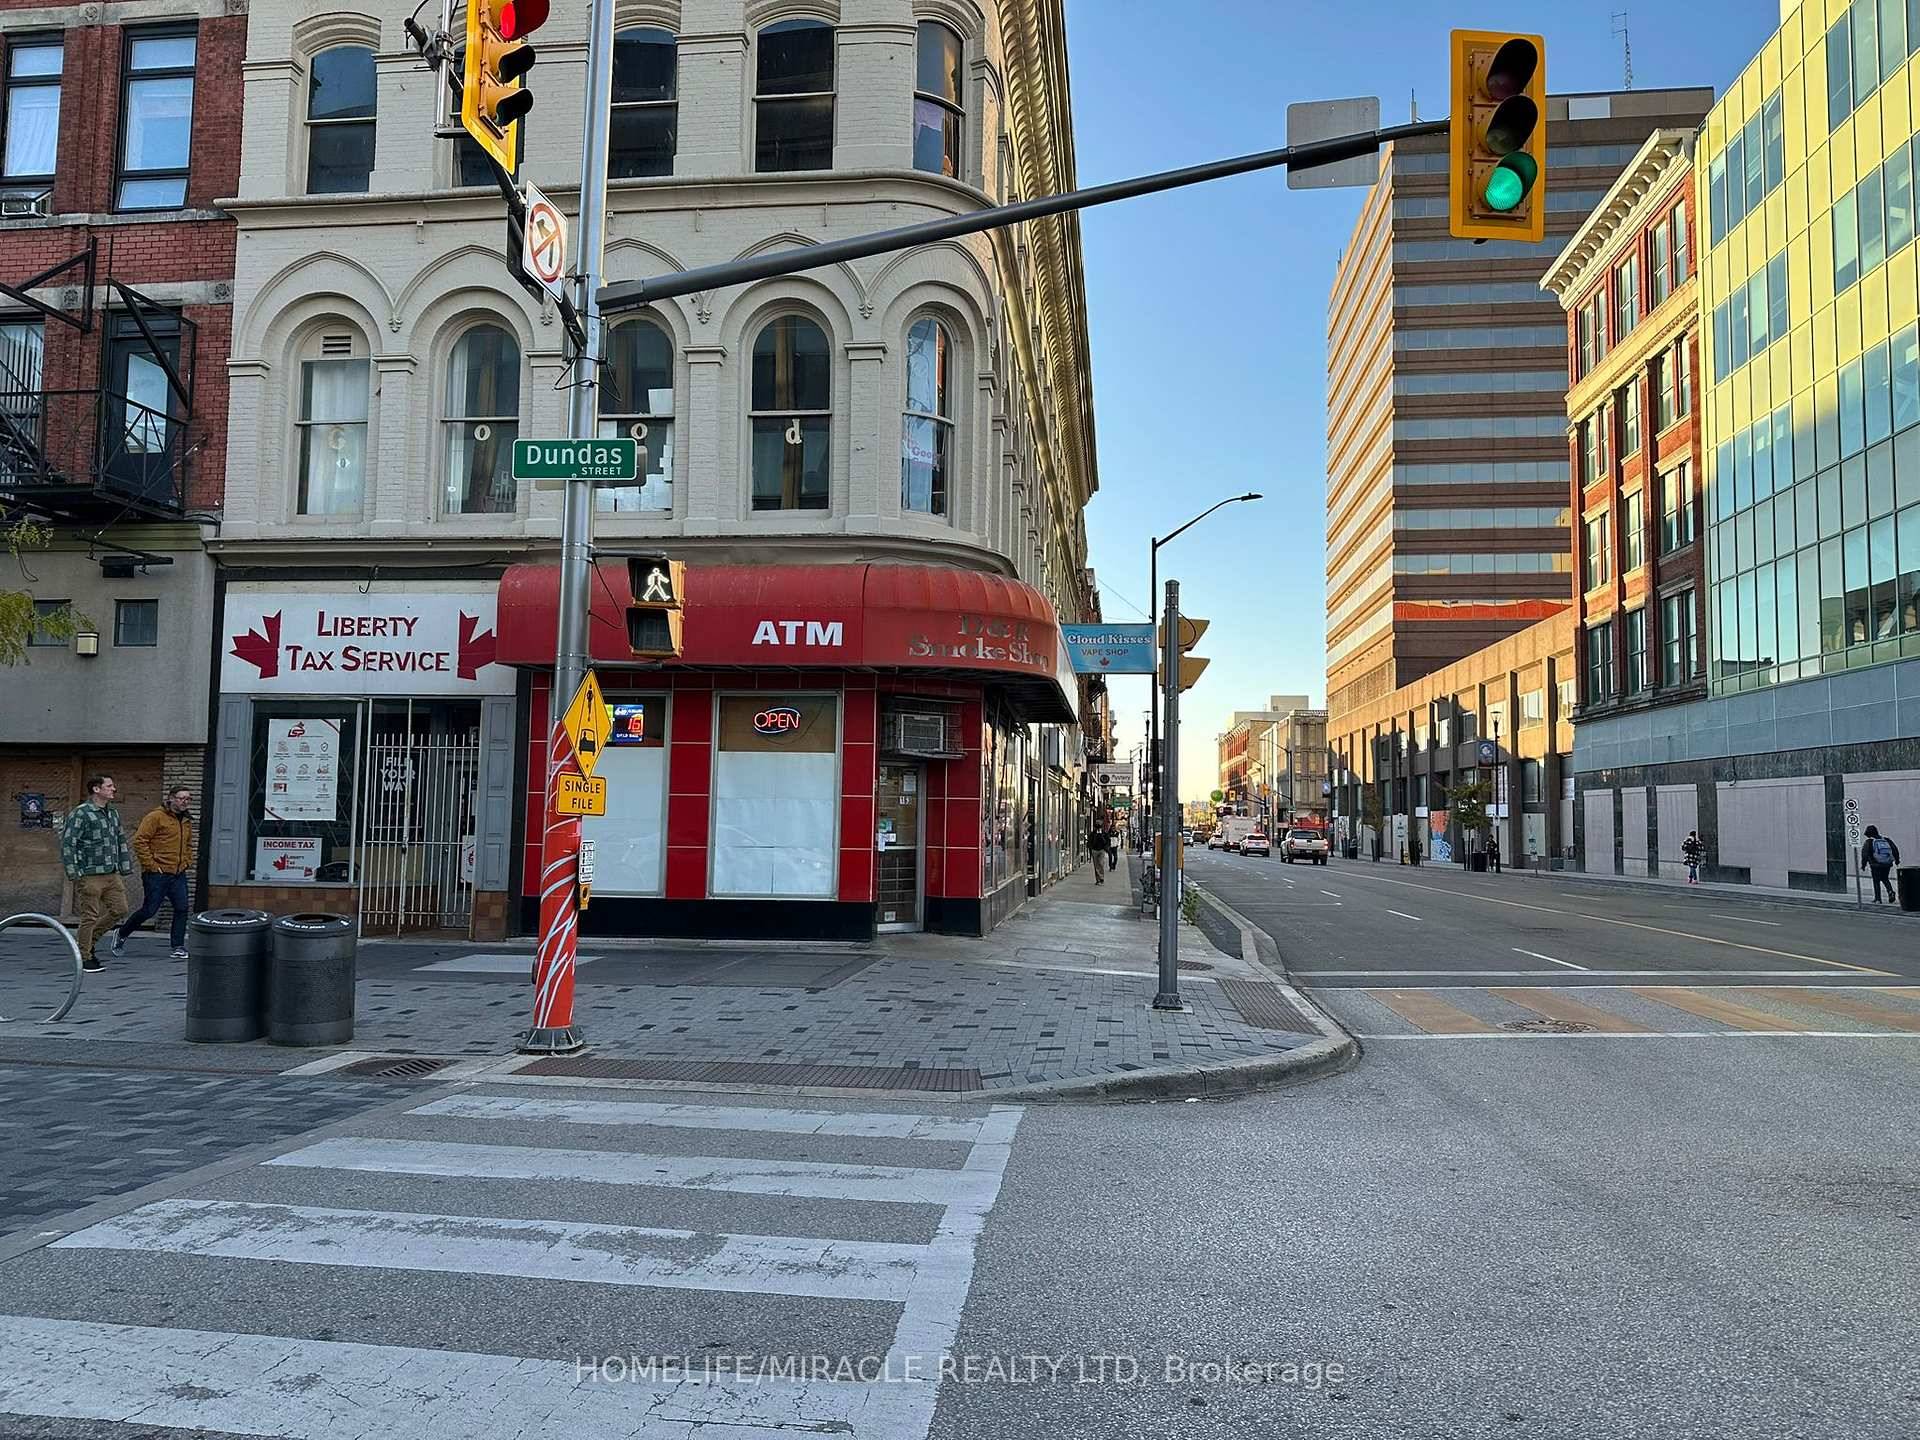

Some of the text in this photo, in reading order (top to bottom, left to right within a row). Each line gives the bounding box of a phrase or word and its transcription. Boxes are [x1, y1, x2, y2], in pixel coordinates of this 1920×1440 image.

[527, 443, 622, 465] Dundas
[581, 466, 622, 476] STREET
[317, 610, 419, 637] LIBERTY
[751, 620, 843, 646] ATM
[1067, 633, 1151, 645] Cloud Kisses
[285, 644, 450, 672] TAX SERVICE
[908, 634, 1049, 672] Smoke Shop
[1081, 648, 1129, 657] VAPE SHOP
[754, 711, 800, 729] OPEN
[380, 769, 416, 779] YOUR
[565, 780, 601, 794] SINGLE
[571, 798, 593, 810] FILE
[263, 841, 315, 849] INCOME TAX
